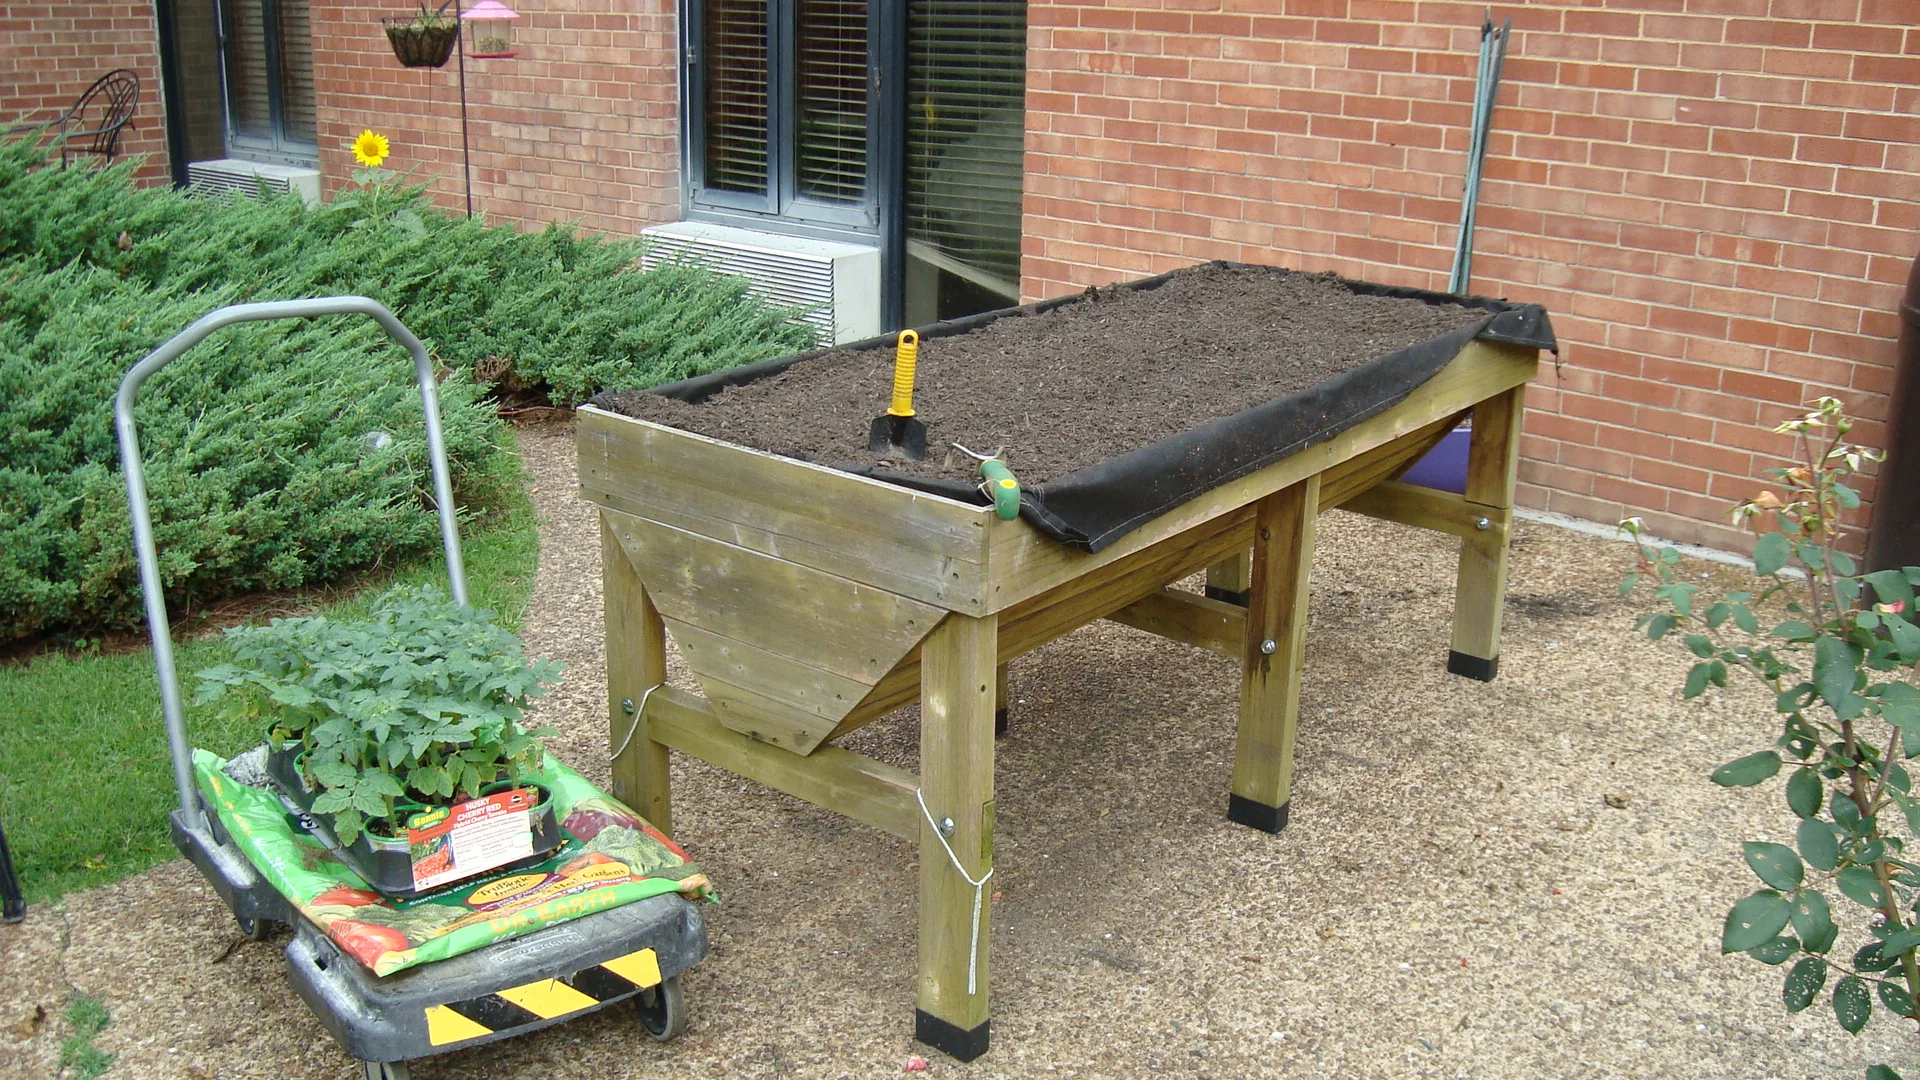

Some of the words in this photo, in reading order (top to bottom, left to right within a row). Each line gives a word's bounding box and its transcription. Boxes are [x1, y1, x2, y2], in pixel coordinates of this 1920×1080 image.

[466, 798, 490, 810] HUSKY
[457, 808, 486, 821] CHERRY
[485, 803, 502, 813] RED
[582, 868, 625, 879] Gardens
[453, 881, 477, 893] KELP
[535, 891, 616, 921] EARTH
